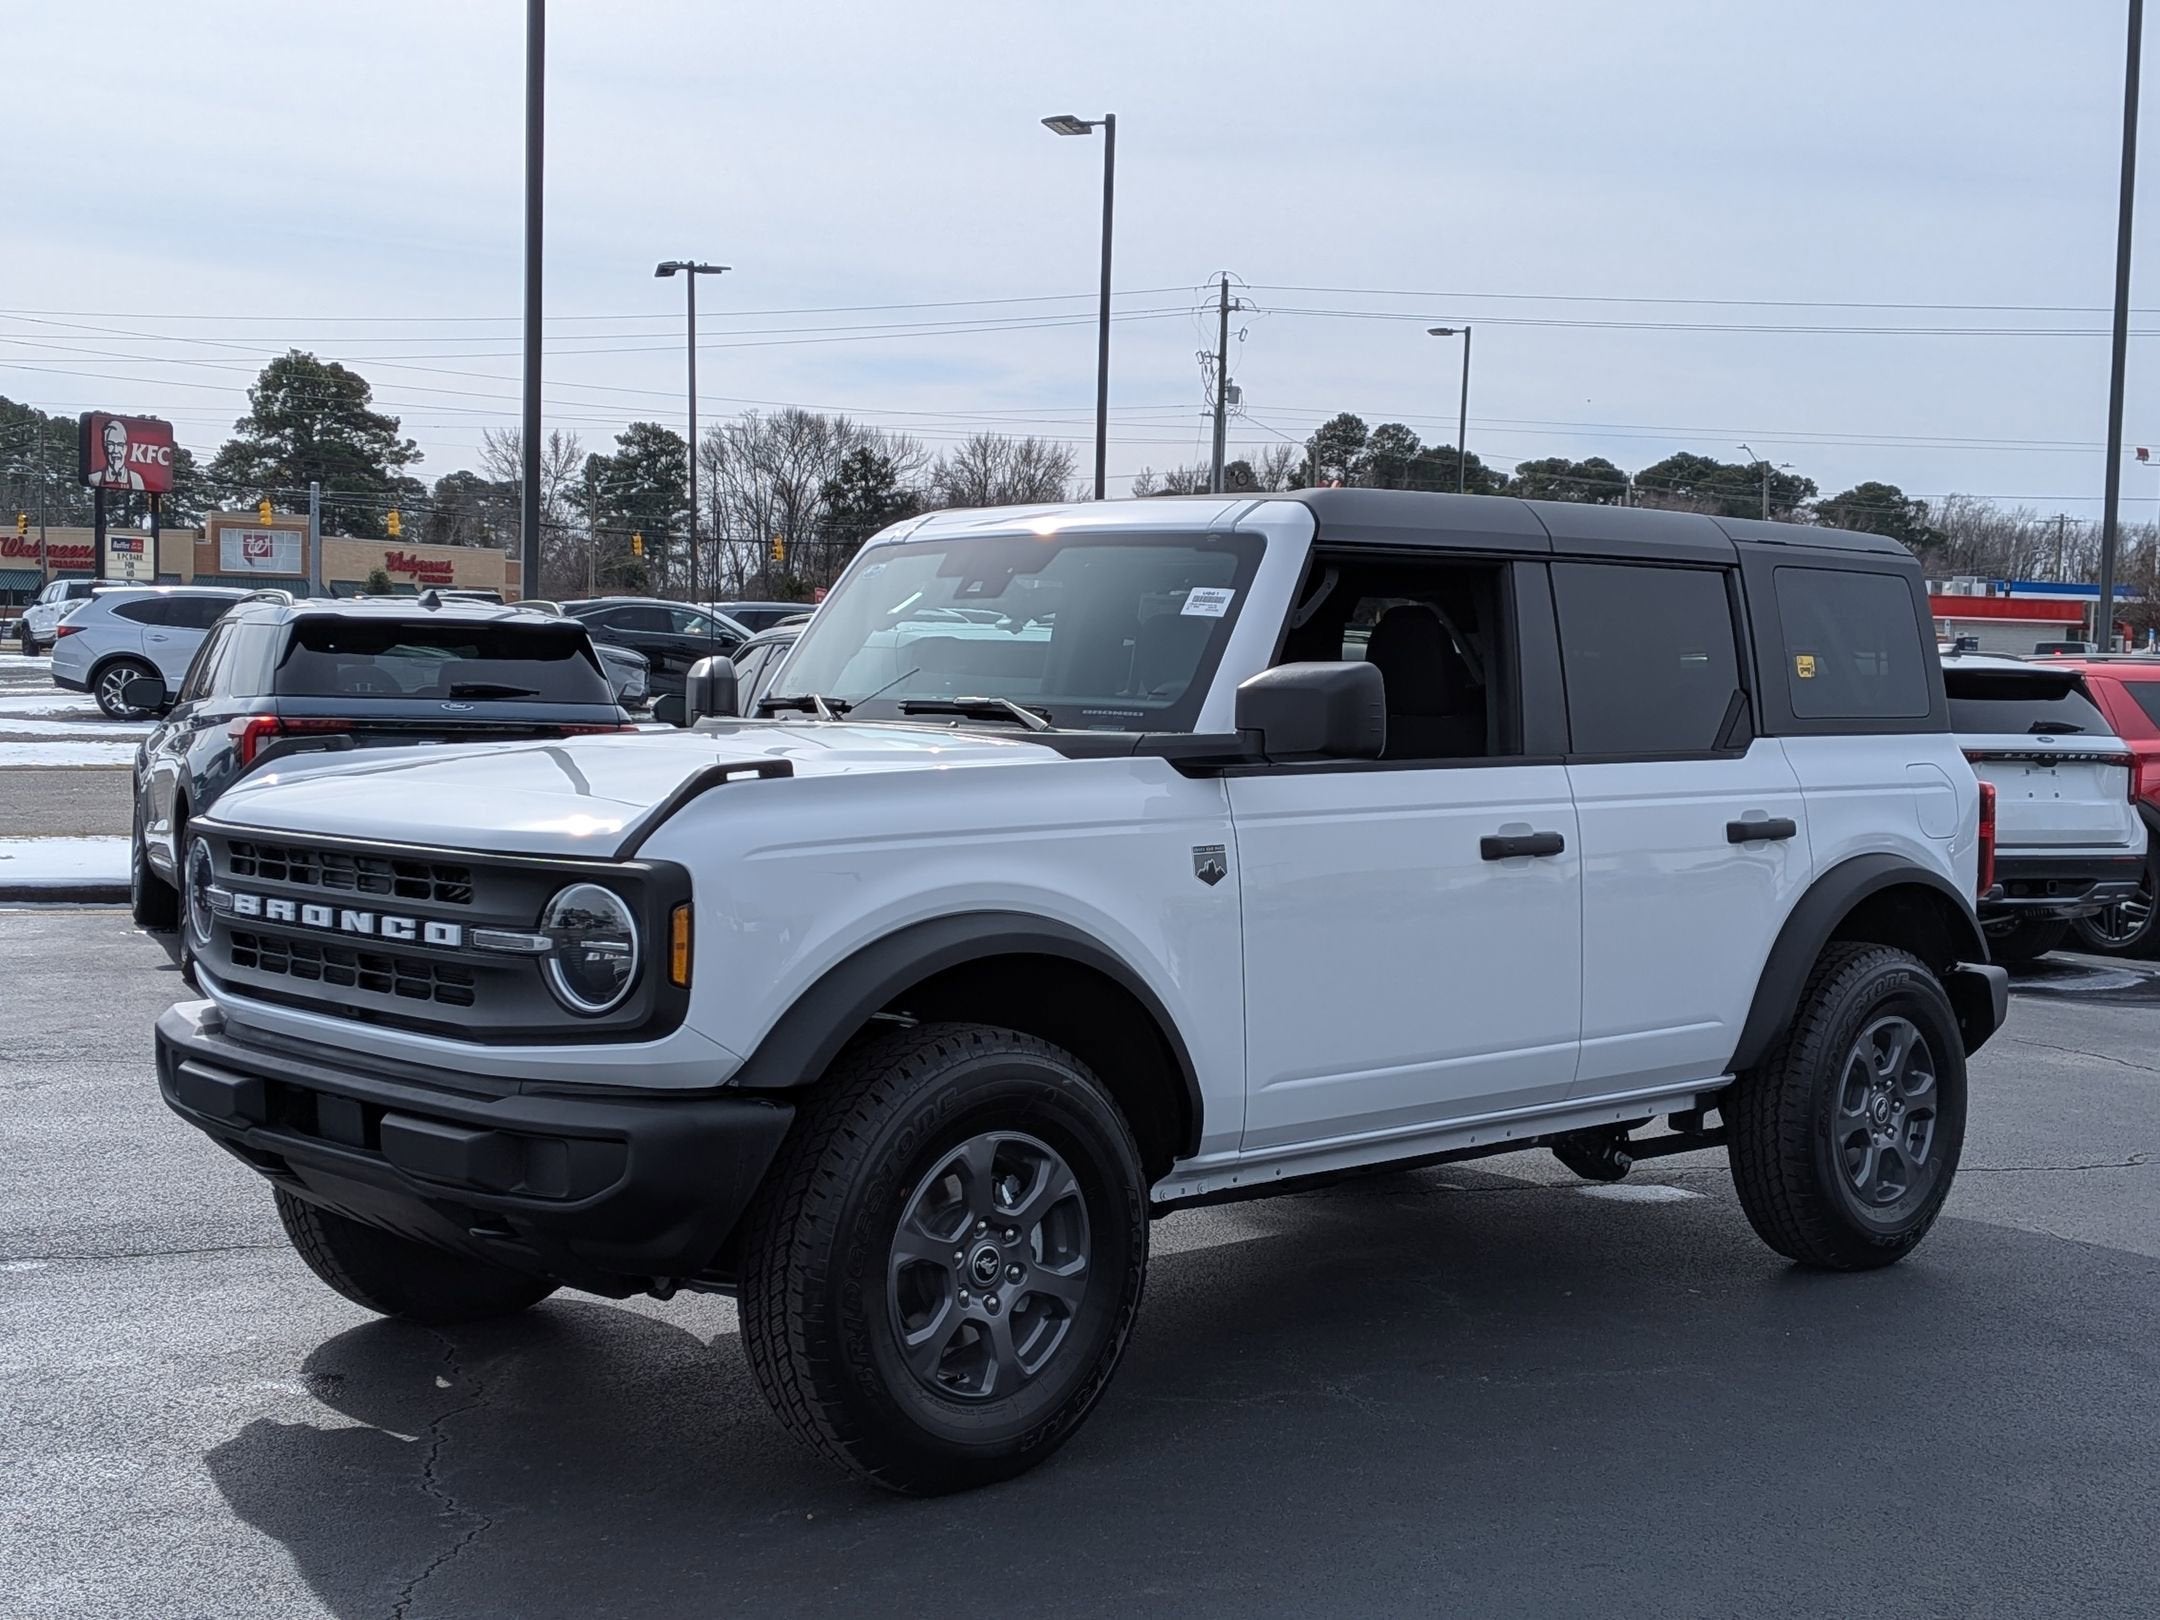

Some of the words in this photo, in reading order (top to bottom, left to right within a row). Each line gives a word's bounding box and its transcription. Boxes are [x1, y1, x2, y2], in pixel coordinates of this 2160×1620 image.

[130, 443, 170, 466] KFC
[2003, 752, 2098, 760] EXPLORER
[233, 892, 462, 947] BRONCO
